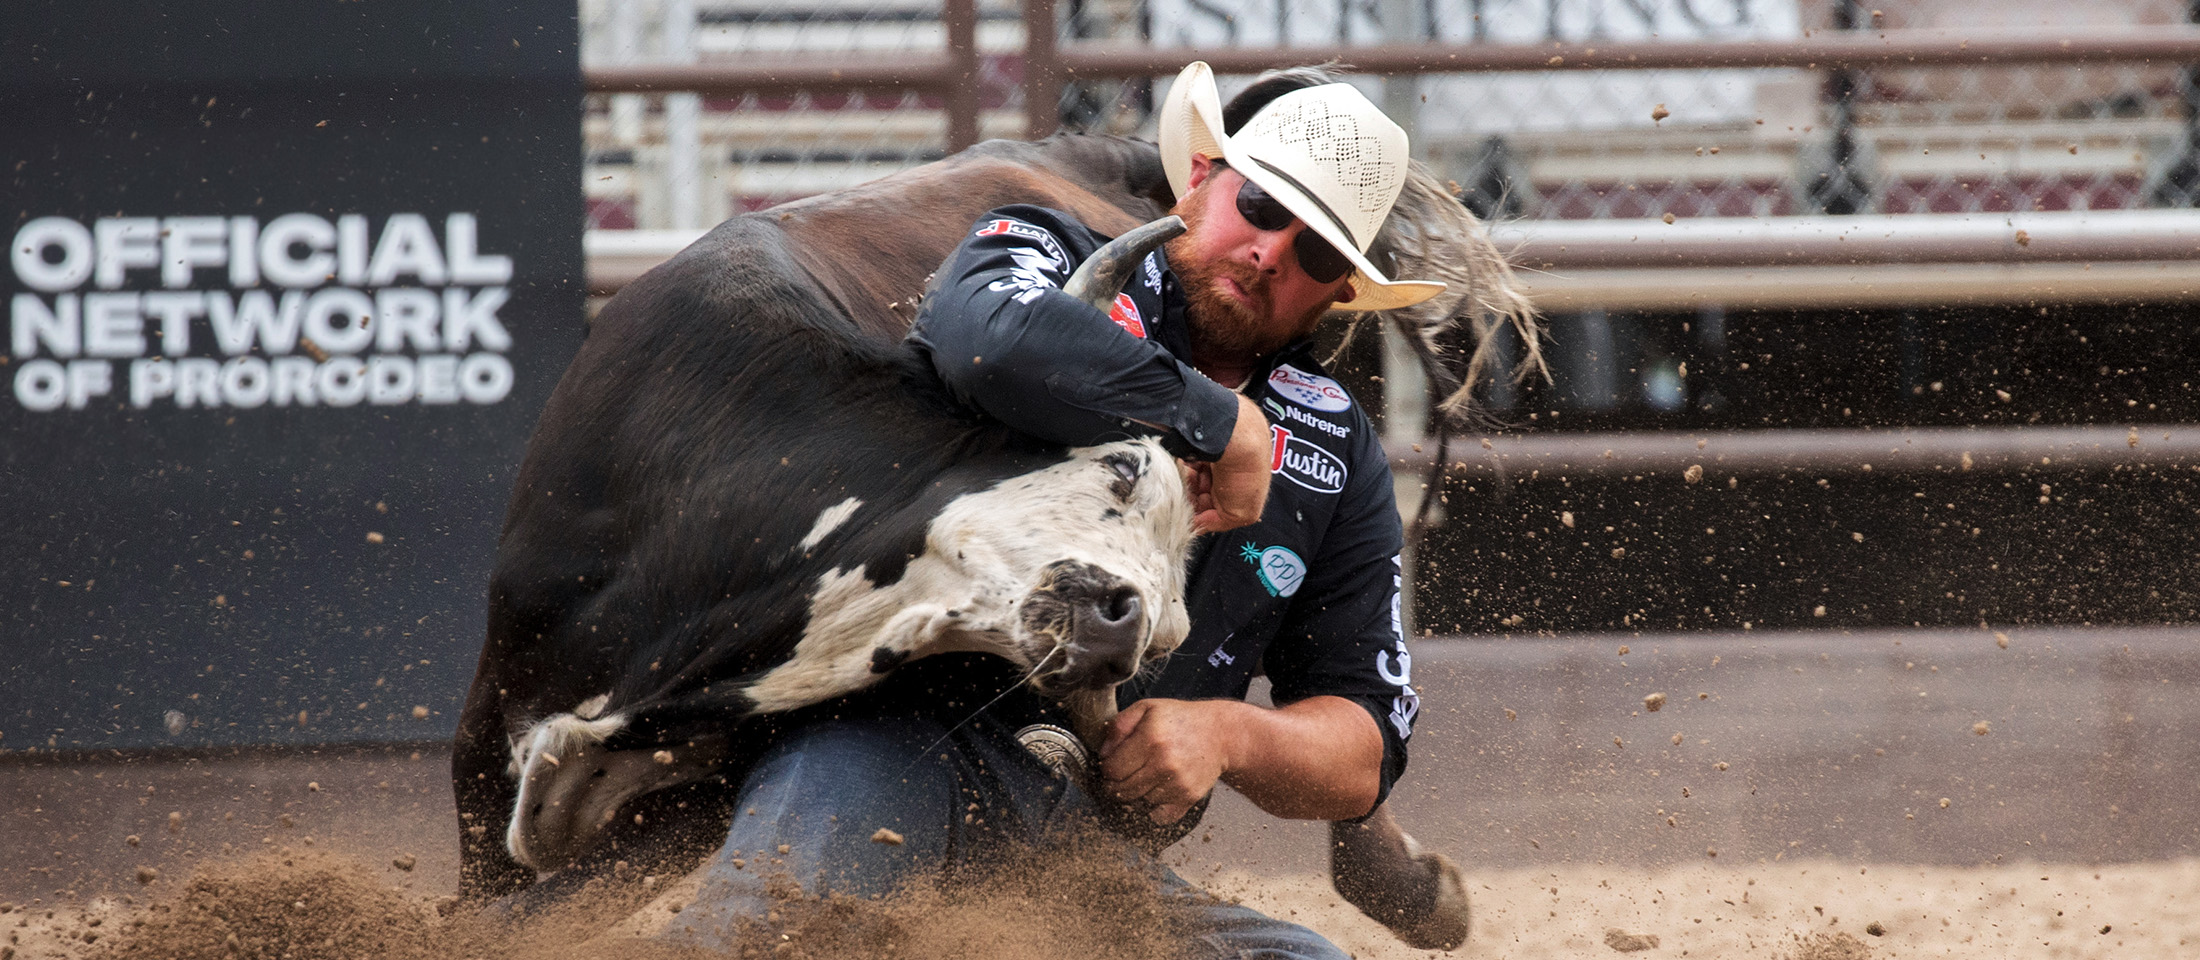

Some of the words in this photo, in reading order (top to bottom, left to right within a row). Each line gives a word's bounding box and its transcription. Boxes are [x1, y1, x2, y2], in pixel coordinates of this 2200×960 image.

[10, 213, 513, 291] OFFICIAL
[976, 219, 1063, 268] Justin
[10, 287, 512, 358] NETWORK
[13, 358, 113, 411] OF
[130, 352, 515, 410] PRORODEO
[1270, 424, 1341, 488] Justin
